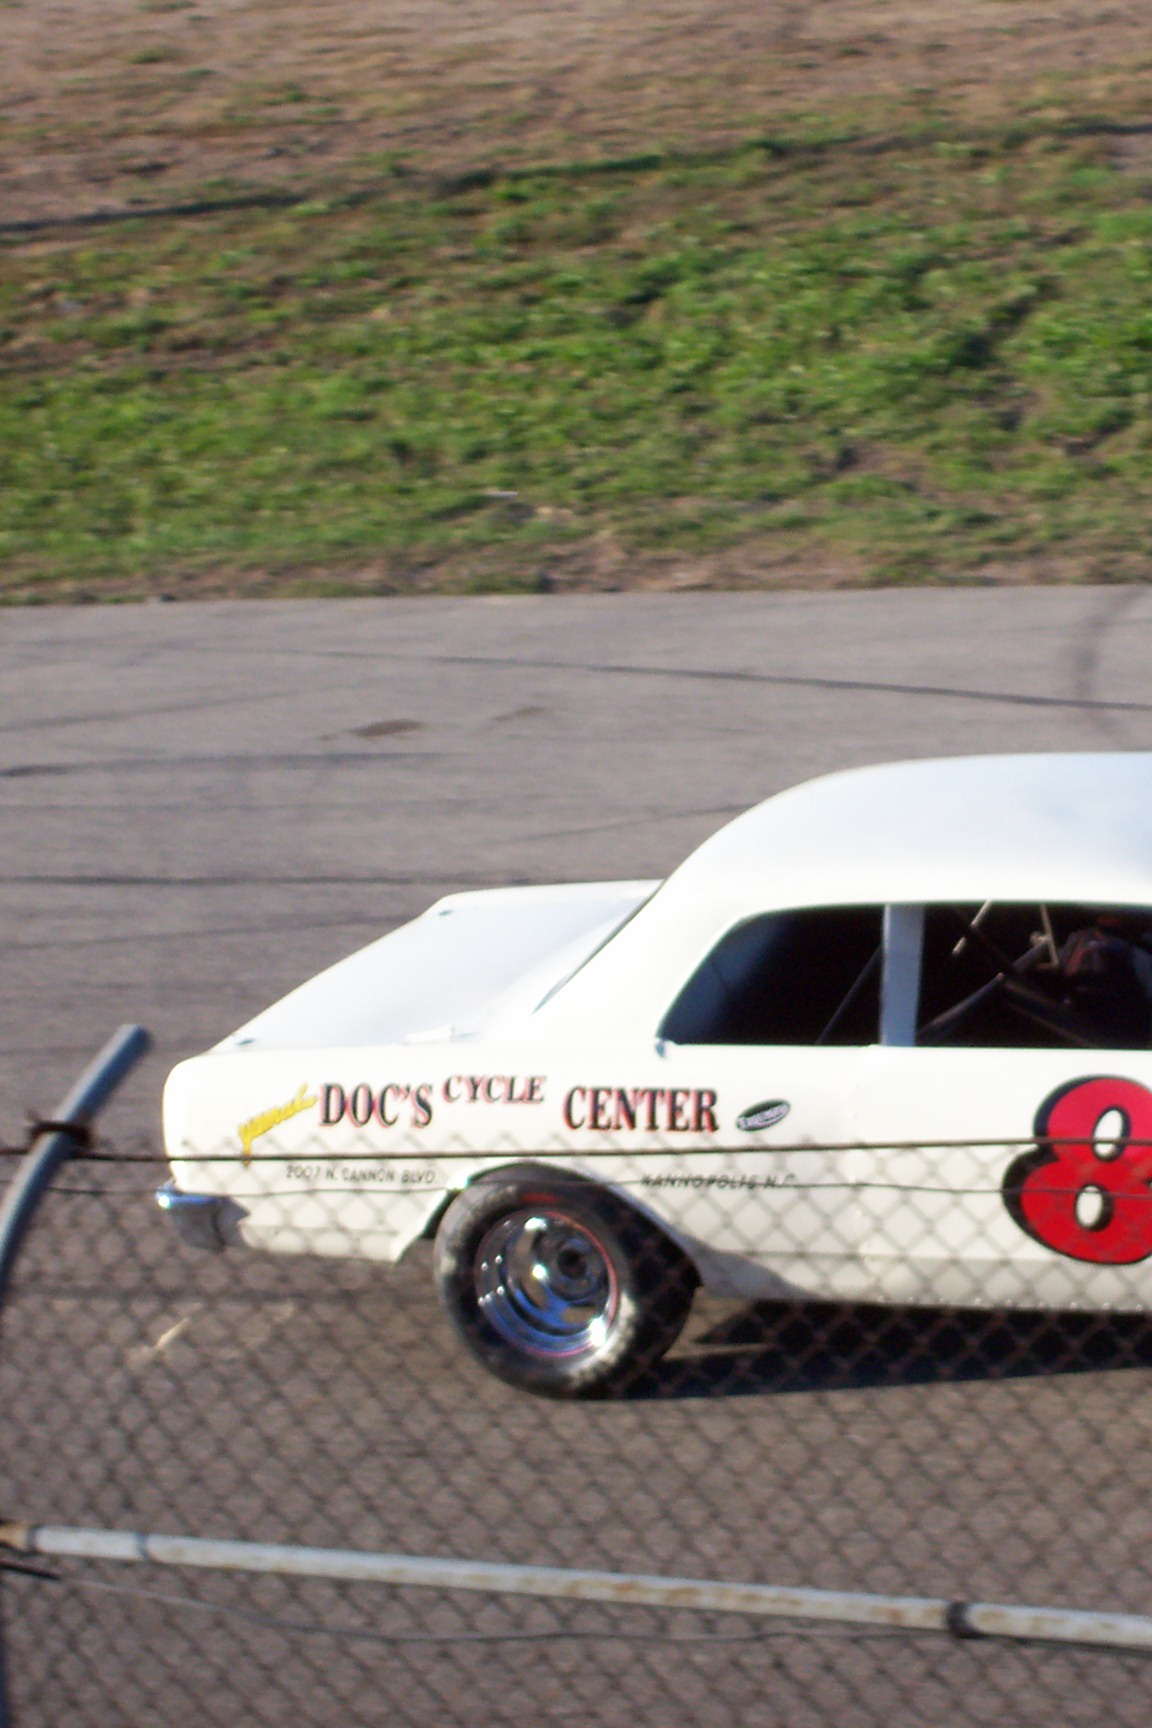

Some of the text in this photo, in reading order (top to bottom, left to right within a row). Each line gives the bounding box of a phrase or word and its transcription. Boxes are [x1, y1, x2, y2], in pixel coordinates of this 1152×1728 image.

[318, 1082, 433, 1129] DOC'S
[442, 1074, 547, 1104] CYCLE
[562, 1085, 720, 1133] CENTER
